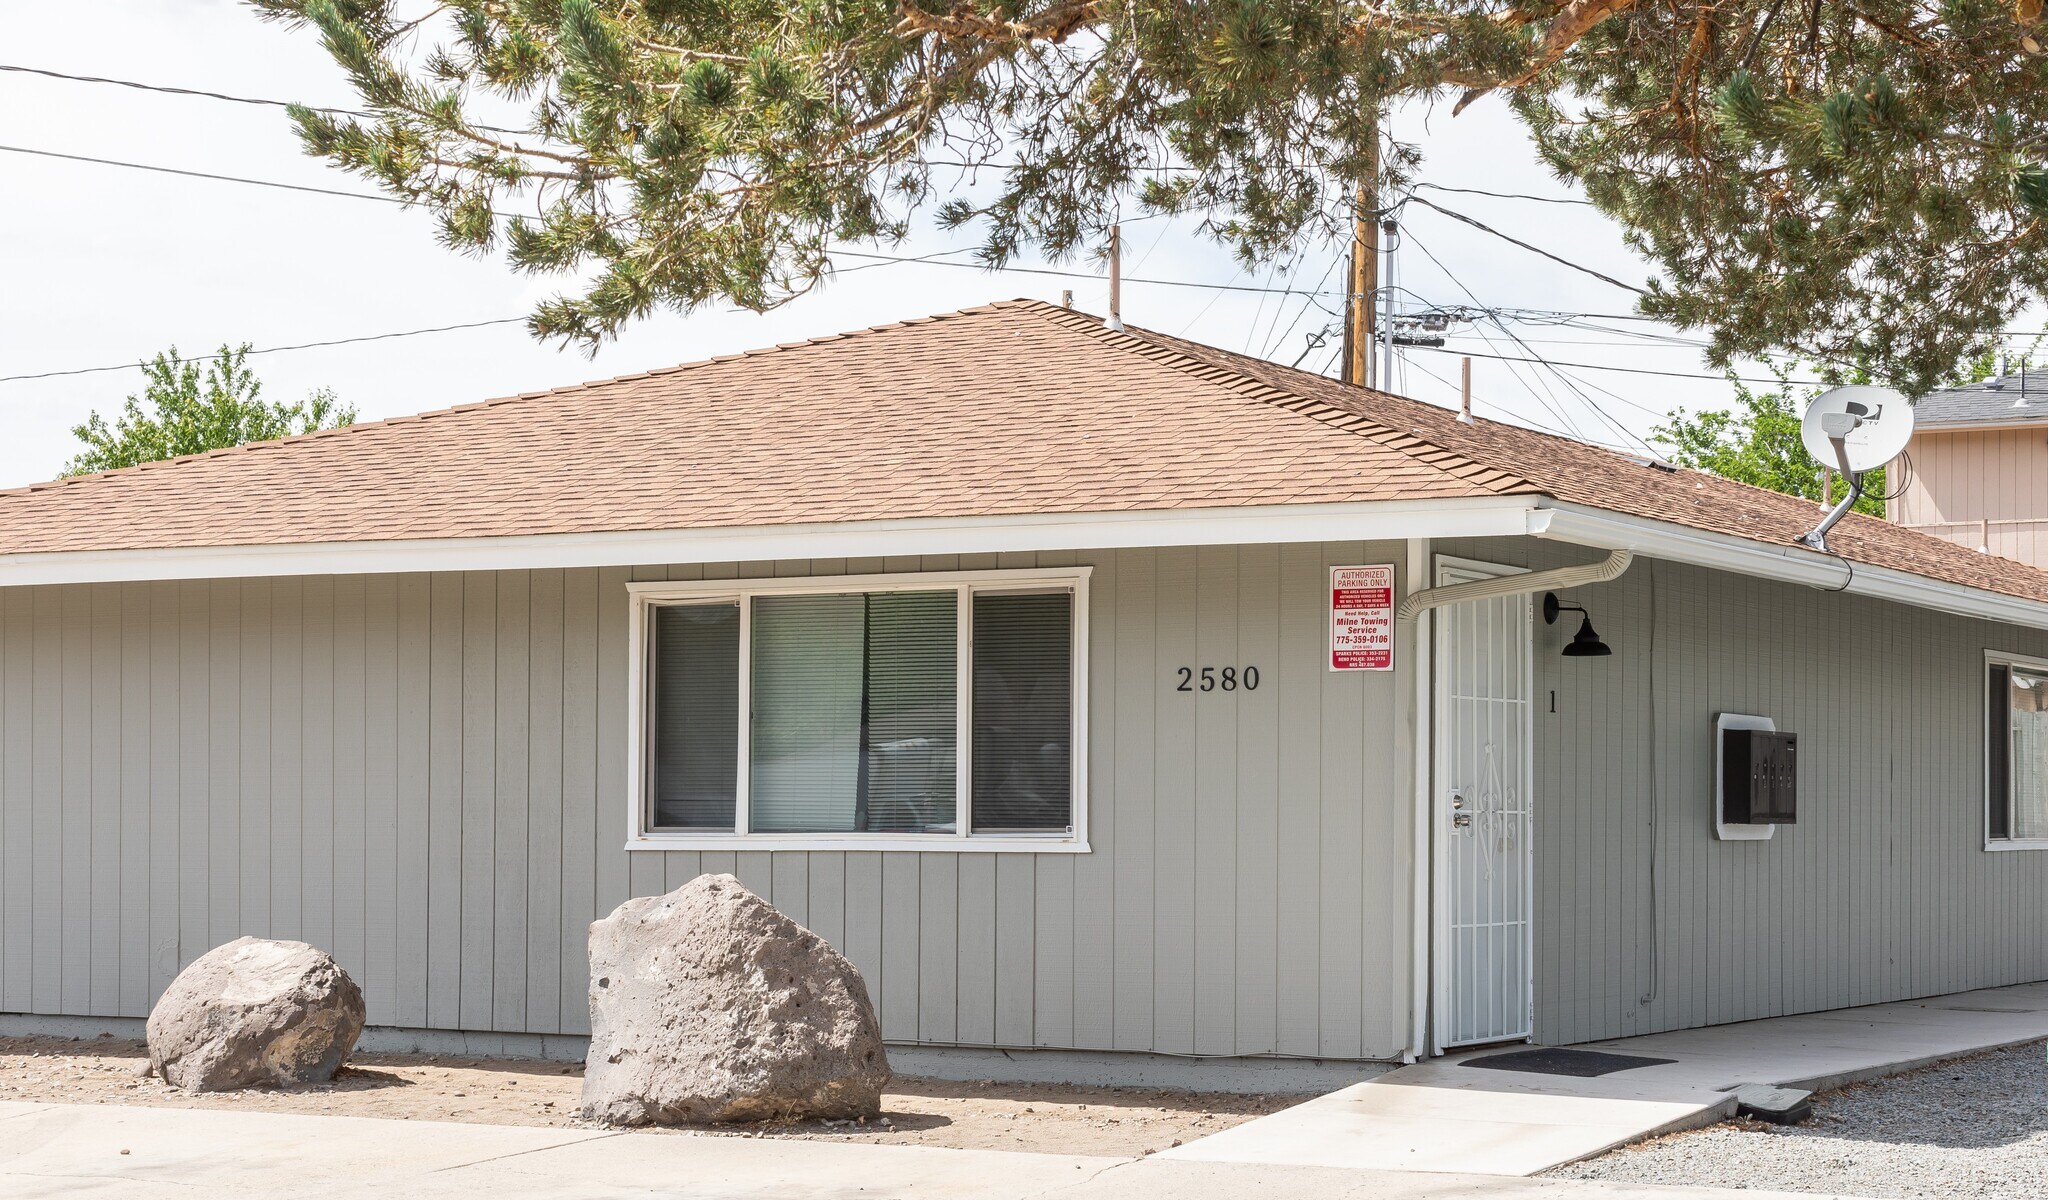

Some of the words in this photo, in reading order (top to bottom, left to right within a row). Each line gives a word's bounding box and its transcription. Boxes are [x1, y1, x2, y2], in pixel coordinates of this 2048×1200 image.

[1361, 617, 1388, 626] Towing
[1337, 635, 1387, 643] 775-359-0106
[1176, 666, 1260, 692] 2580
[1550, 690, 1556, 713] 1
